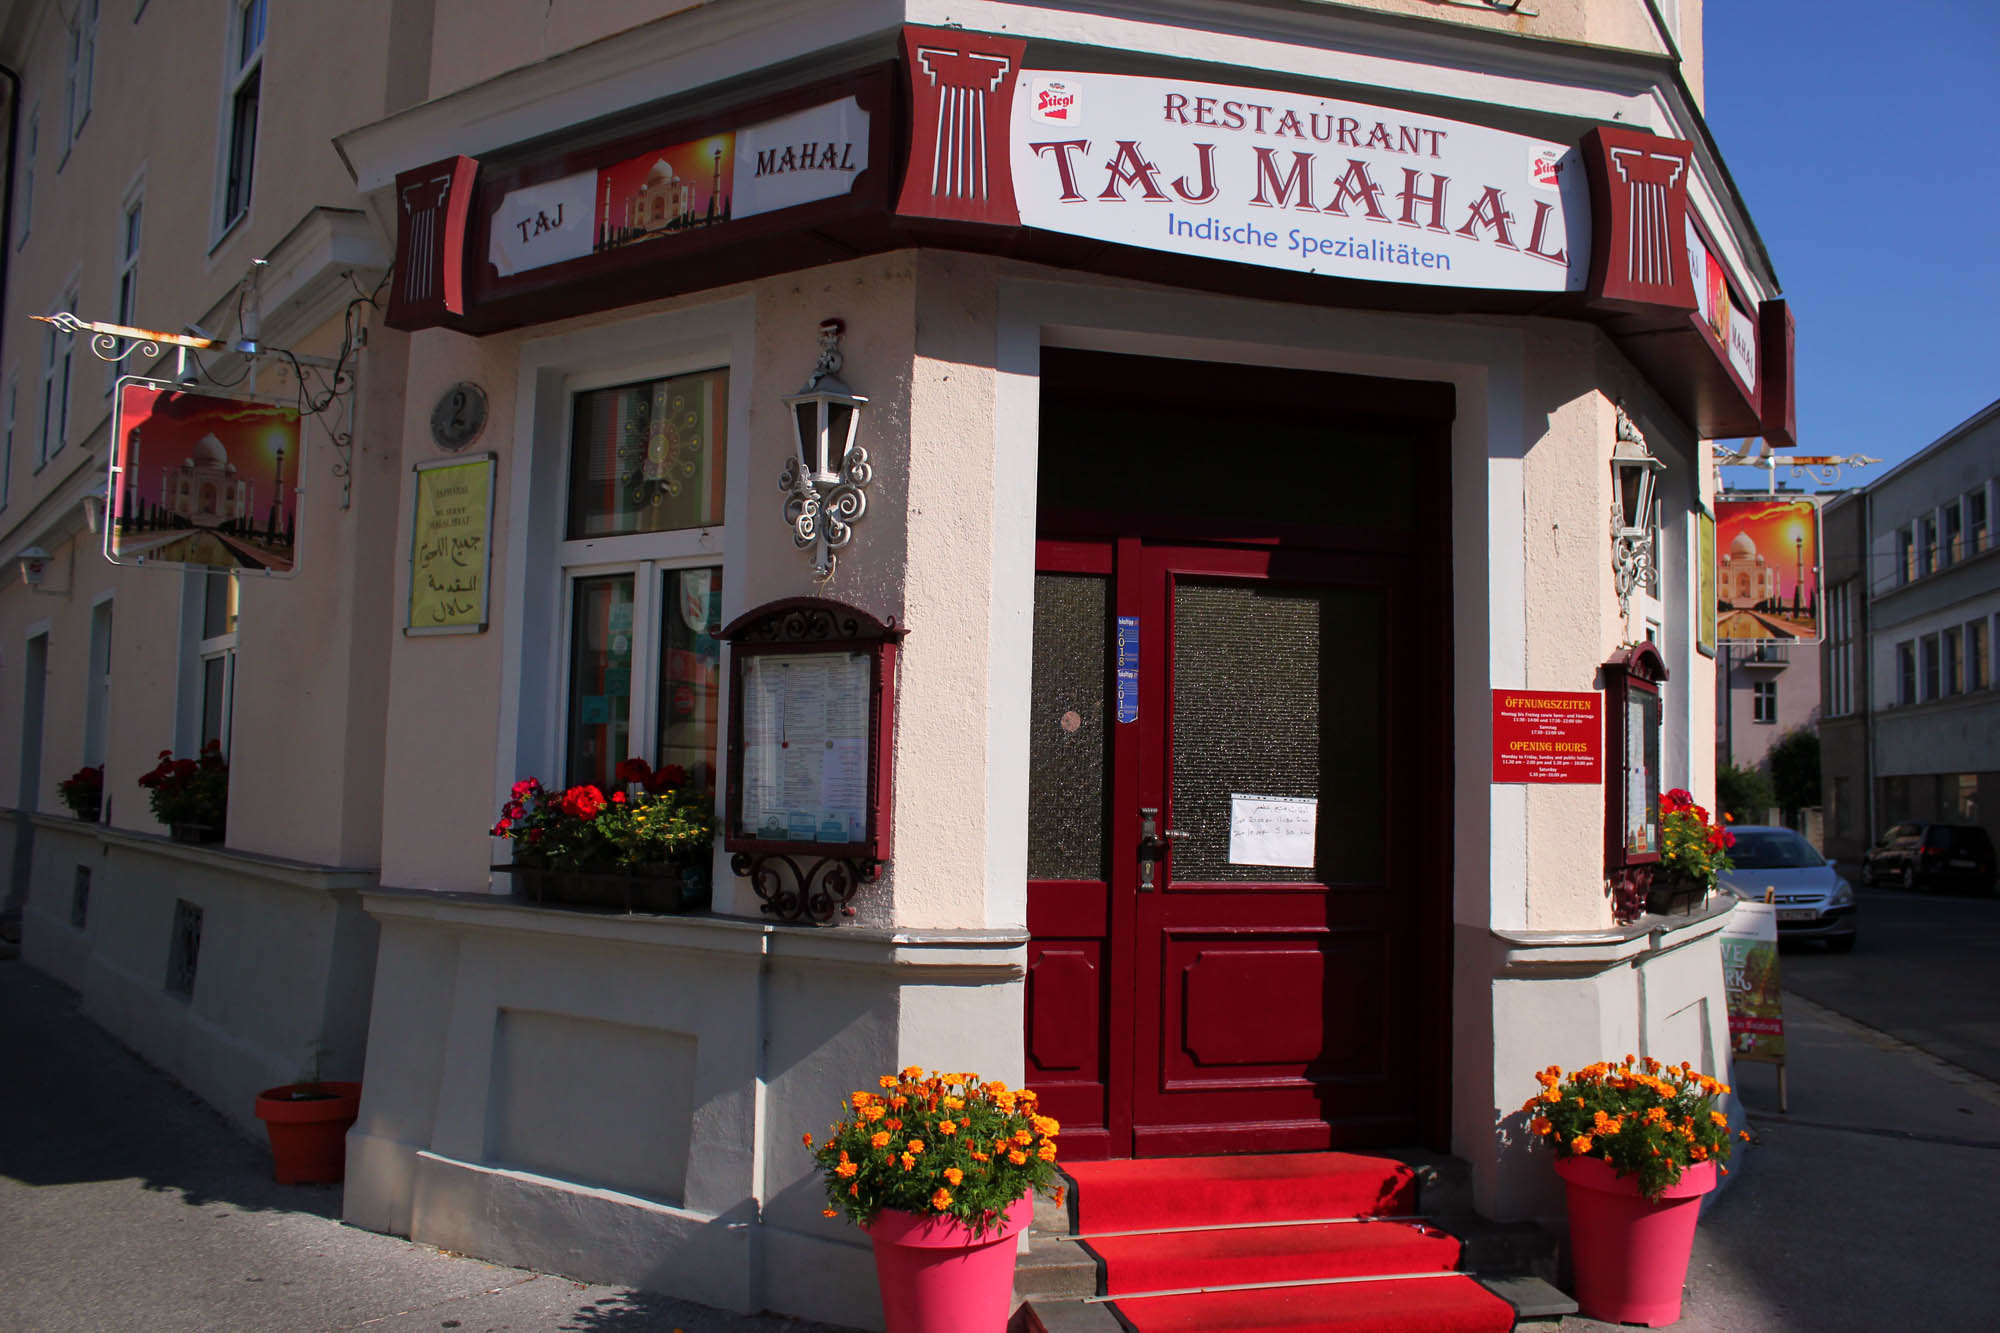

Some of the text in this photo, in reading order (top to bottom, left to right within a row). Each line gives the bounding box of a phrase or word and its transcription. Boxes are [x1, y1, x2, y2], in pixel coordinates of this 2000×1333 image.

[1038, 90, 1074, 111] Stiegl
[1164, 93, 1447, 159] RESTAURANT
[754, 142, 857, 178] MAHAL
[1534, 158, 1564, 177] Stiegl
[1029, 139, 1572, 268] TAJ MAHAL
[516, 203, 564, 244] TAJ
[1168, 213, 1452, 271] Indische Spezialitäten
[1732, 323, 1754, 380] MAHAL
[451, 391, 467, 427] 2
[1505, 696, 1591, 710] ÖFFNUNGSZEITEN
[1510, 741, 1588, 753] OPENING HOURS
